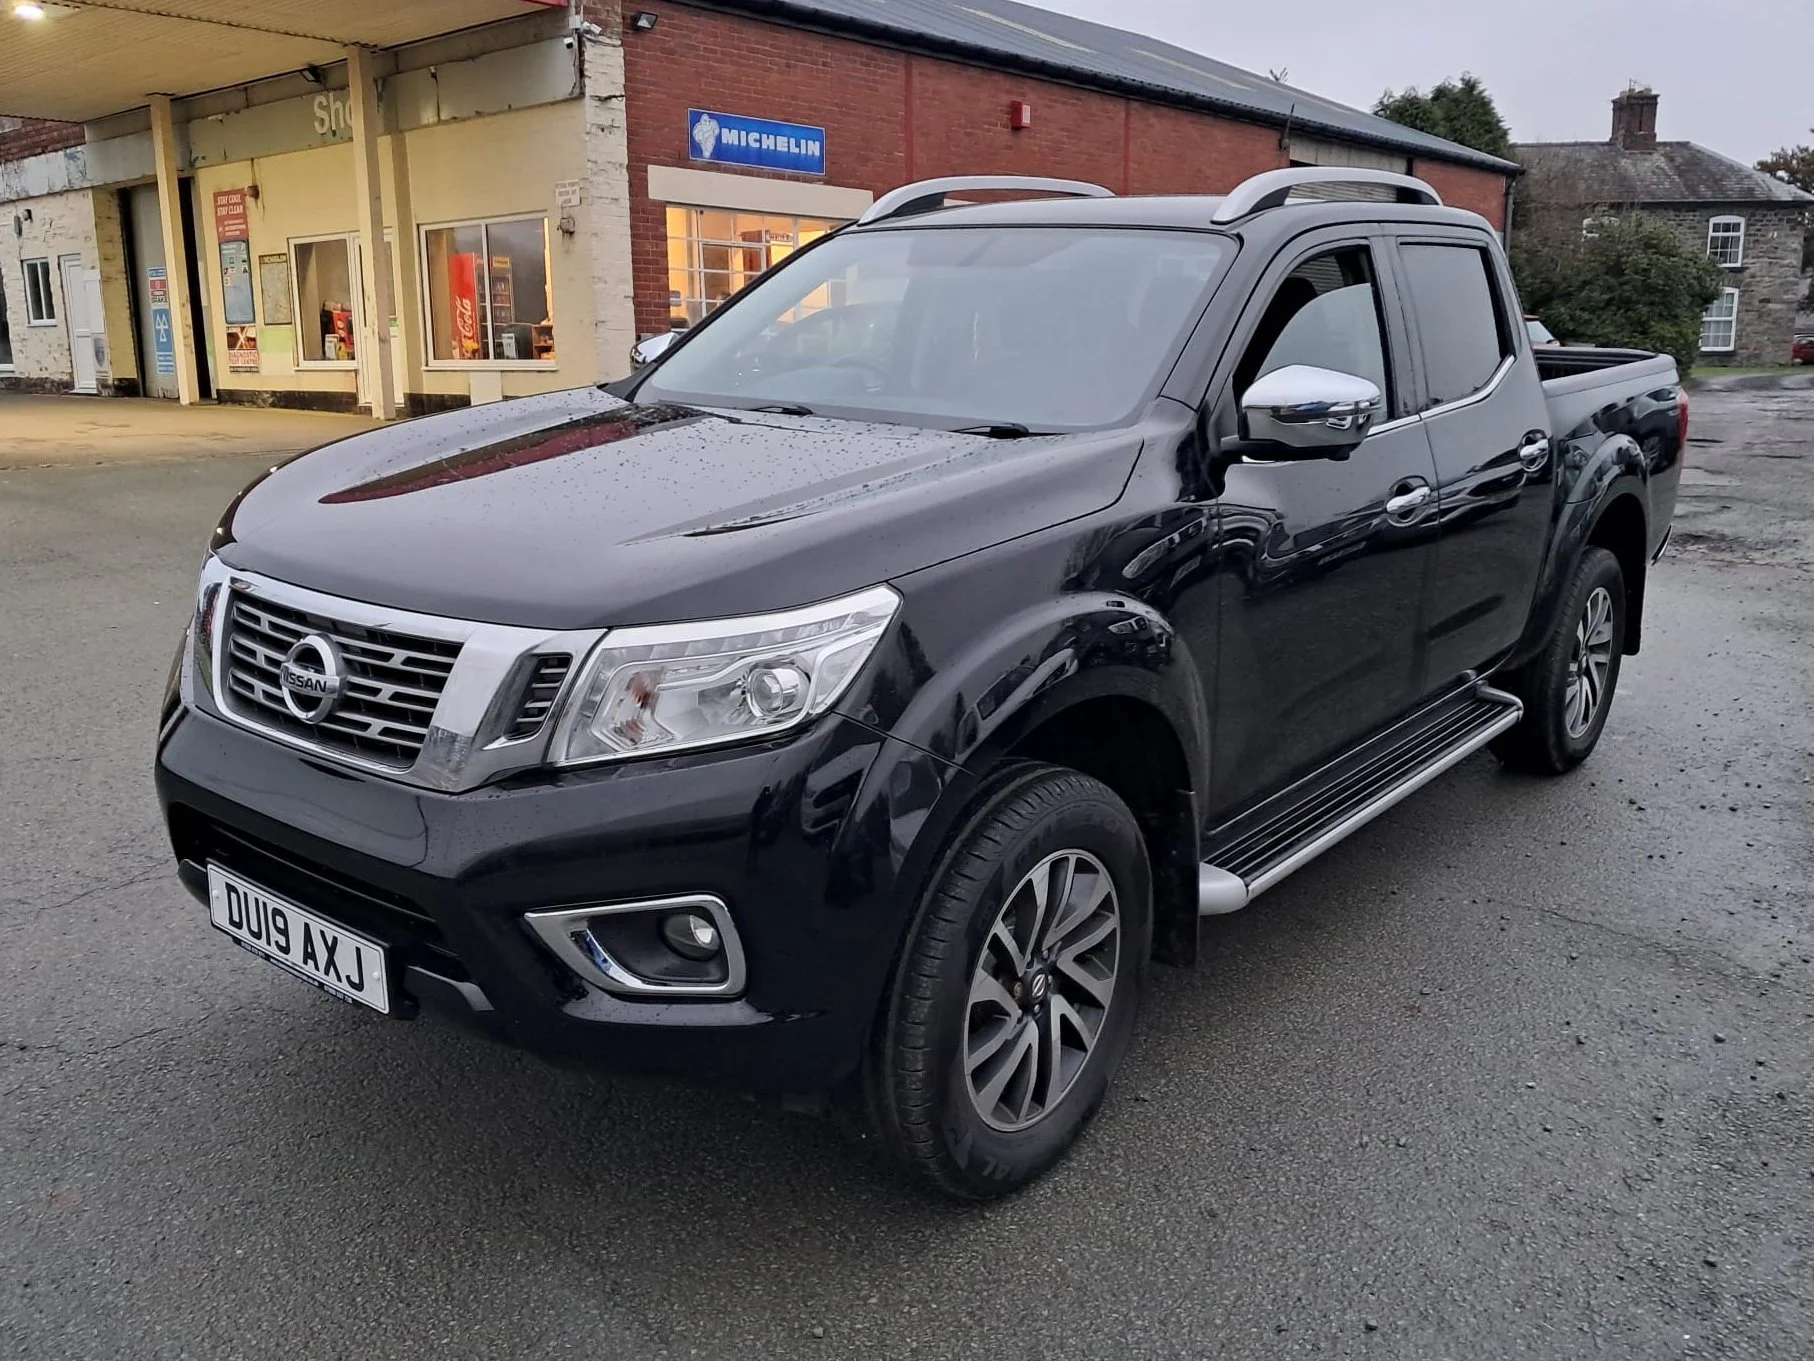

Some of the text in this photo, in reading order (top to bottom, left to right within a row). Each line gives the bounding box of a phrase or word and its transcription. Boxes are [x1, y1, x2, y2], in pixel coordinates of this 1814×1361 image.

[721, 128, 820, 156] MICHELIN
[217, 194, 241, 205] STAY COOL
[217, 205, 243, 216] STAY CLEAN
[281, 665, 327, 692] NISSAN
[225, 881, 291, 955] DU19
[303, 922, 365, 992] AXJ
